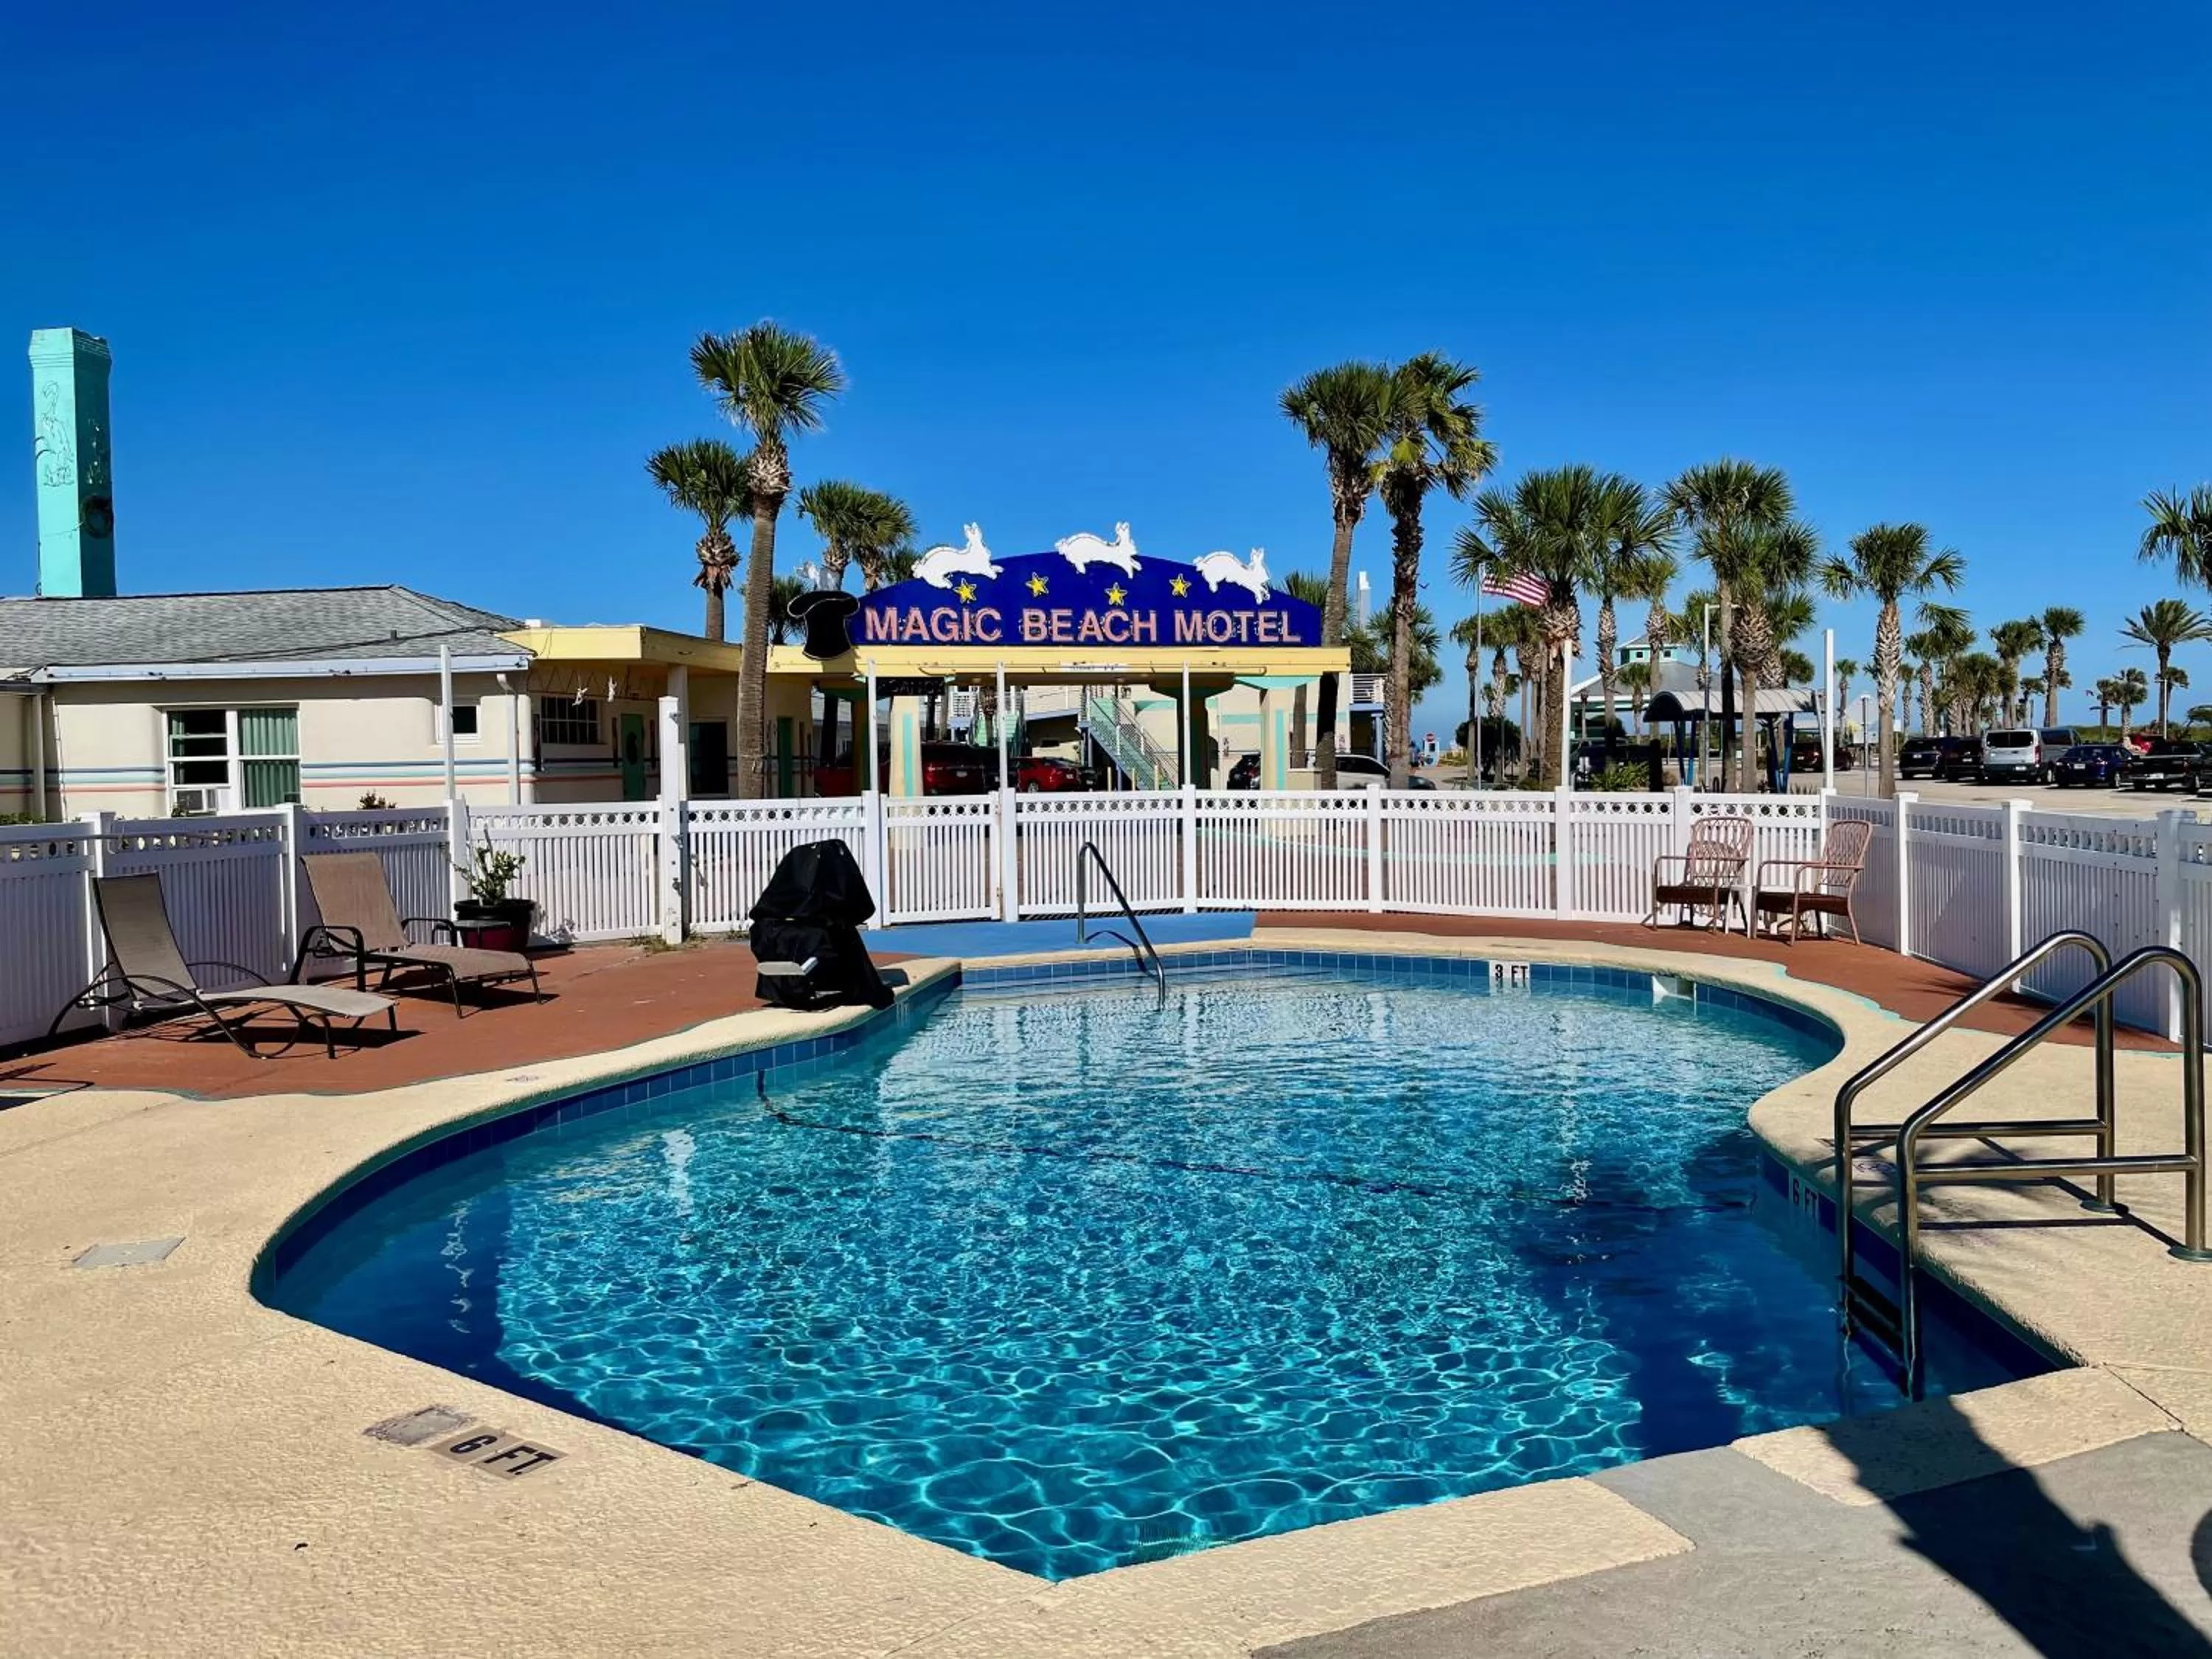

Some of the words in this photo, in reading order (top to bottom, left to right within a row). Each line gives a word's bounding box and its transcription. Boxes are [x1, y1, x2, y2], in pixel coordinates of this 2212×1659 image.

[864, 607, 1003, 642] MAGIC
[1020, 608, 1158, 643] BEACH
[1174, 609, 1302, 644] MOTEL
[1495, 964, 1503, 979] 3
[1792, 1178, 1801, 1206] 6
[449, 1434, 498, 1454] 6
